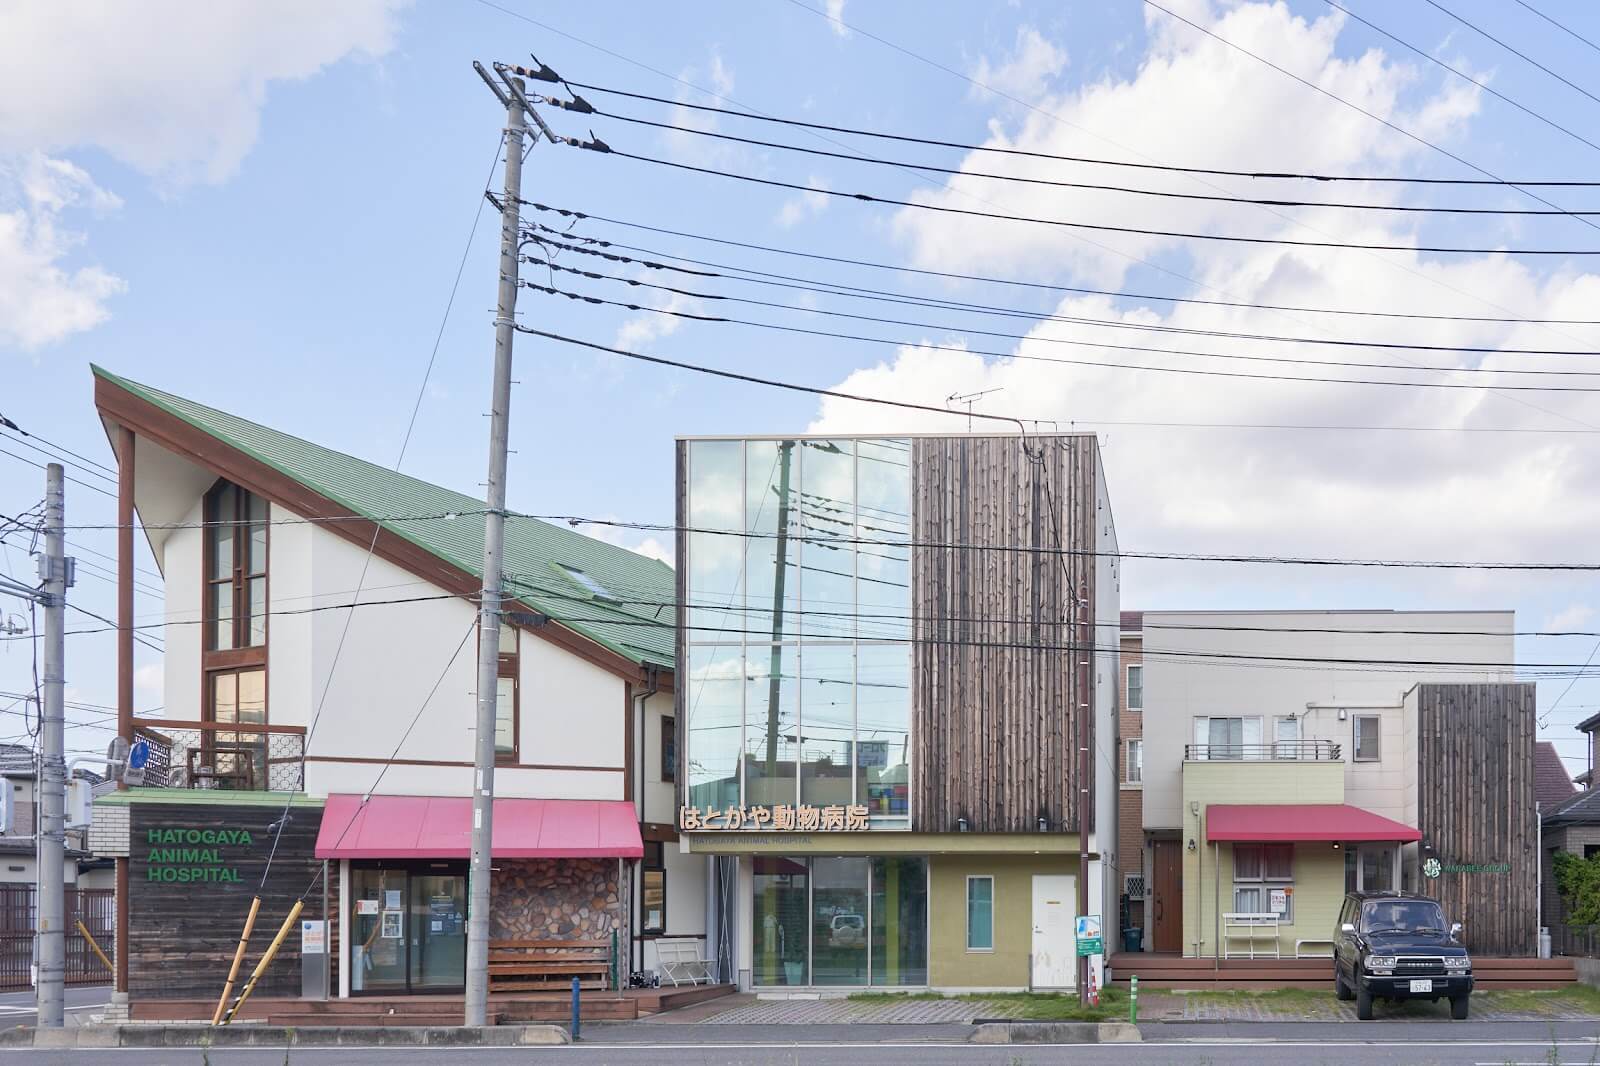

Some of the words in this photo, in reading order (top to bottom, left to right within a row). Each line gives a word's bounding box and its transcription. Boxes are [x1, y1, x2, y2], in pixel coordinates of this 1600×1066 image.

[679, 804, 870, 831] はとがや動物病院
[148, 829, 252, 844] HATOGAYA
[147, 848, 225, 863] ANIMAL
[148, 867, 245, 882] HOSPITAL
